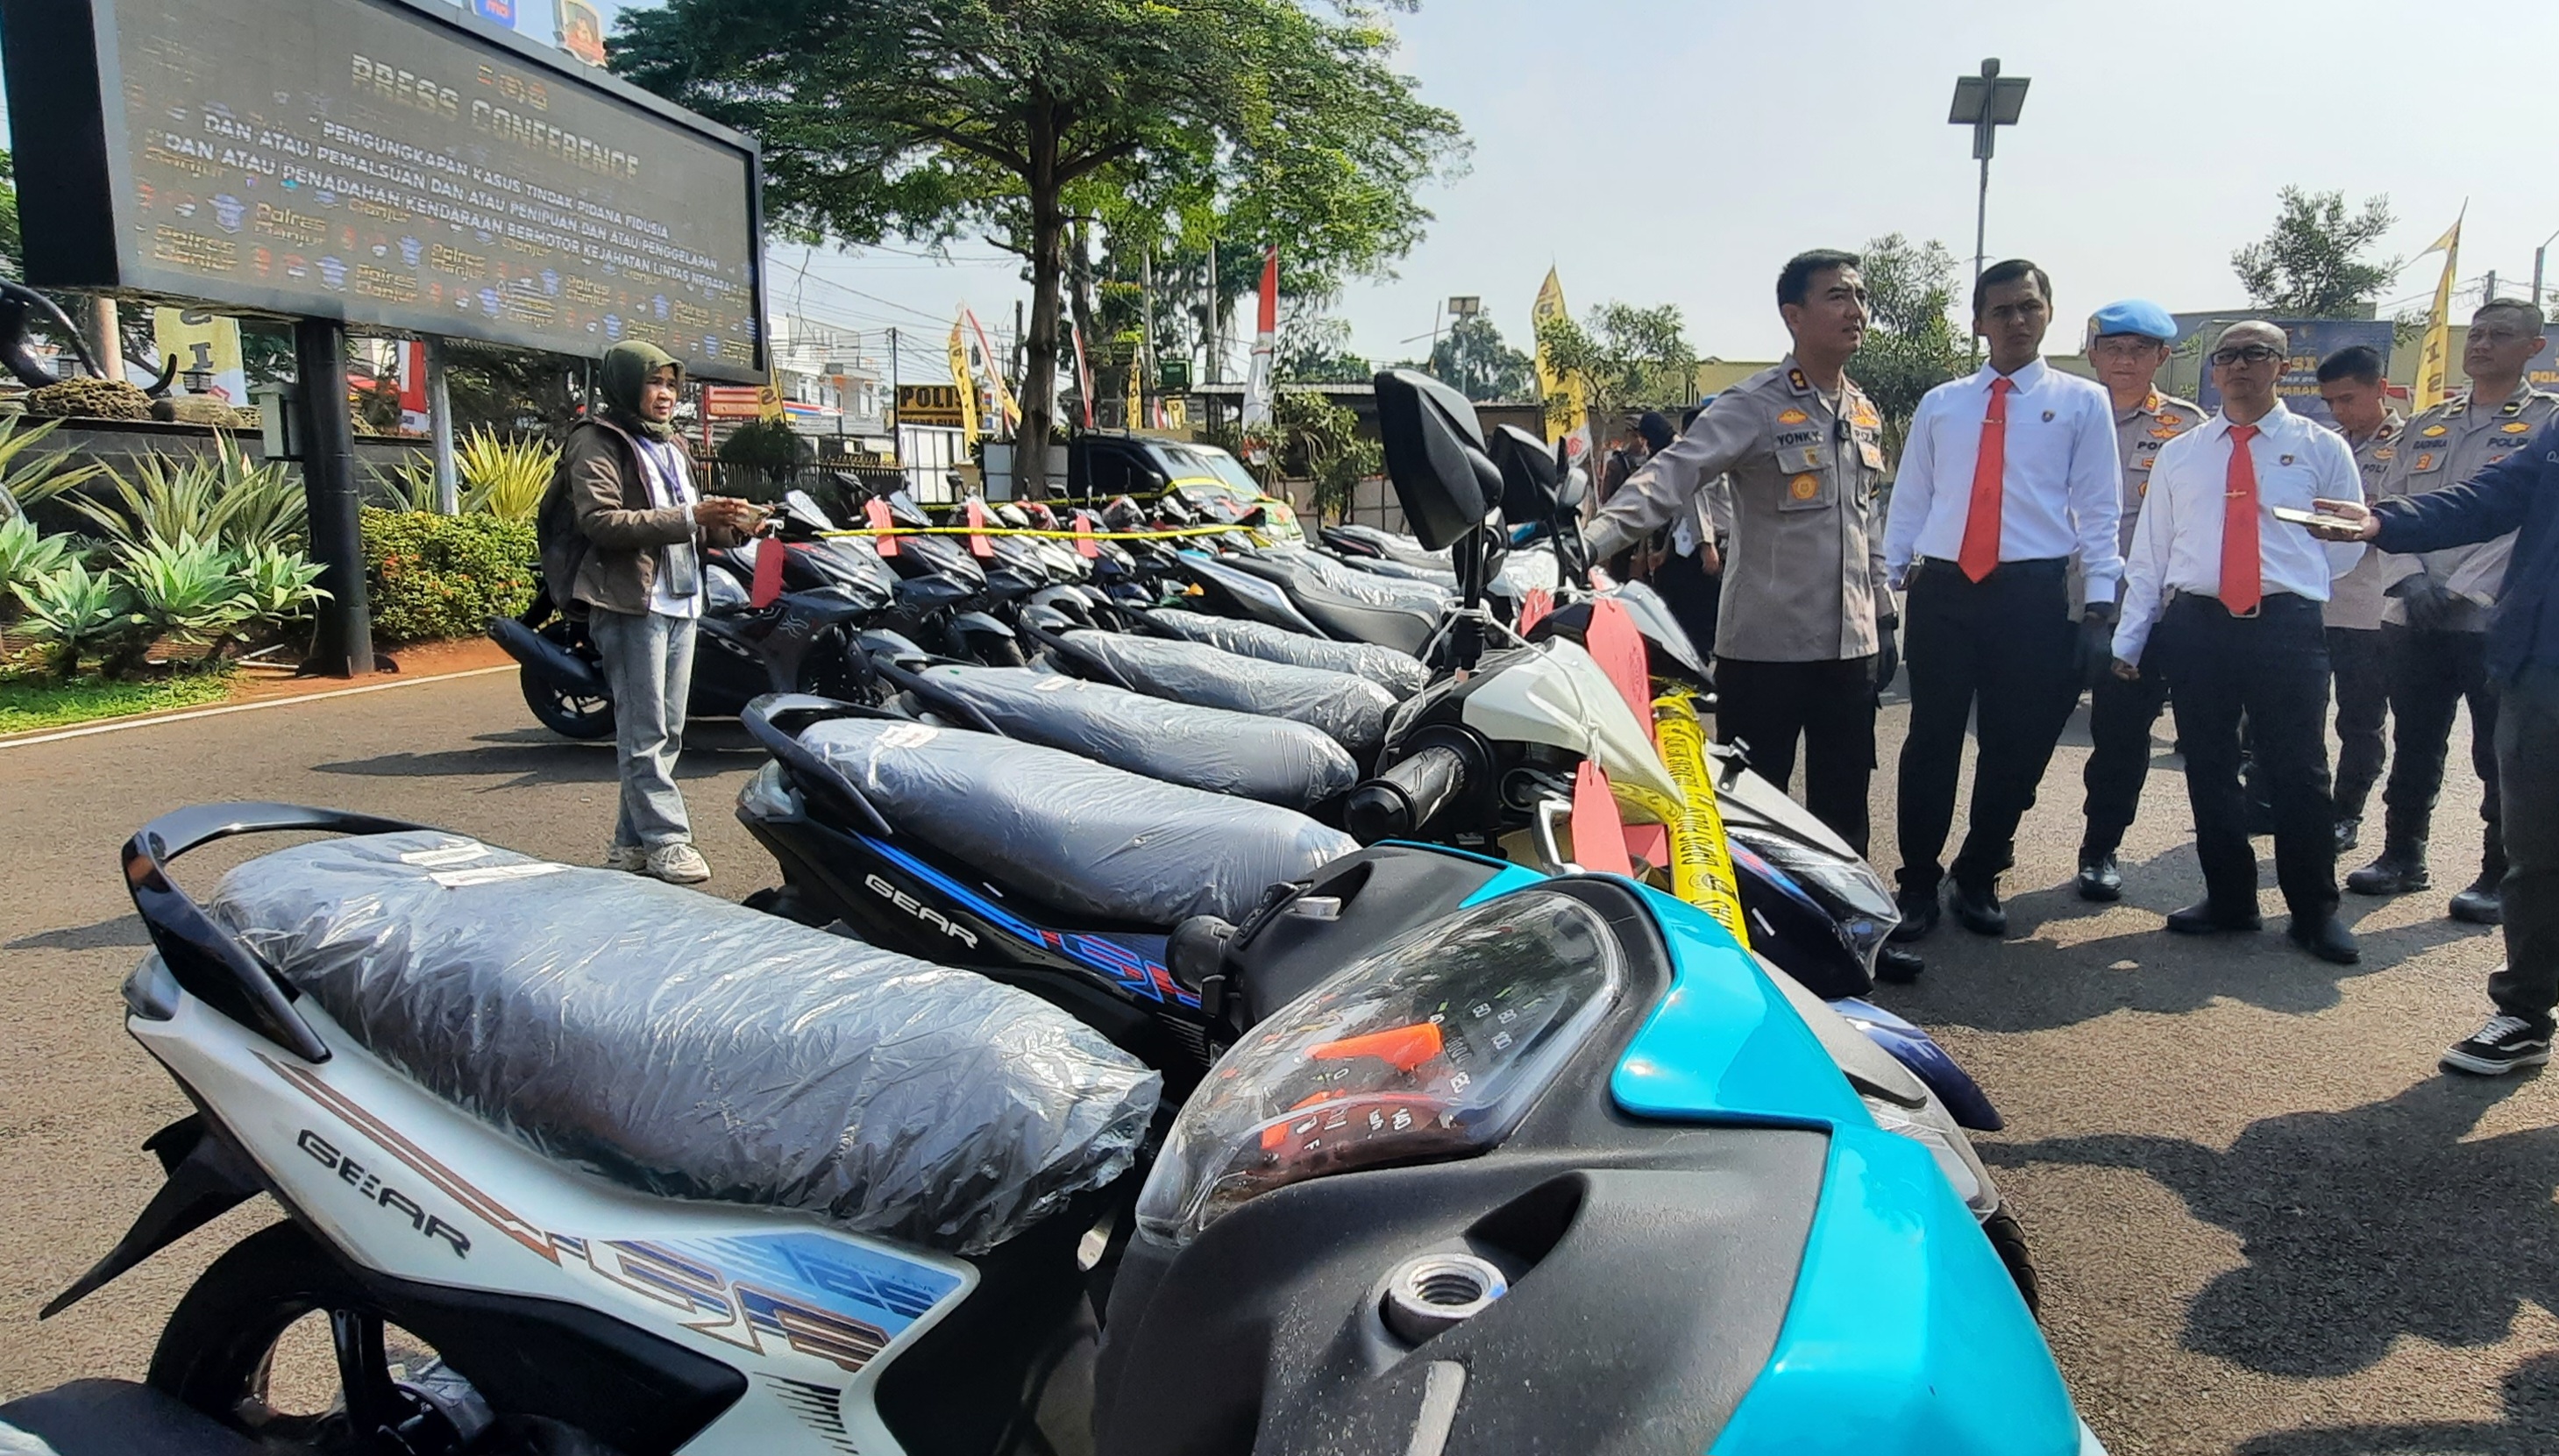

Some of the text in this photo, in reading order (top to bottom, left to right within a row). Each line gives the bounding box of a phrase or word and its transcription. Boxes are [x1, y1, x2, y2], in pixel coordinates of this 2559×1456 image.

[352, 53, 639, 177] PRESS CONFERENCE
[164, 132, 731, 292] DAN ATAU PENADAHAN KENDARAAN BERMOTOR KEJAHATAN LINTAS NEGARA
[203, 114, 718, 272] DAN ATAU PEMALSUAN DAN ATAU PENIPUAN DAN ATAU PENGGELAPAN
[255, 202, 326, 231] Polres
[323, 120, 669, 239] PENGUNGKAPAN KASUS TINDAK PIDANA FIDUSIA
[1777, 430, 1820, 445] YONKY
[864, 873, 978, 949] GEAR
[296, 1128, 472, 1260] GEAR
